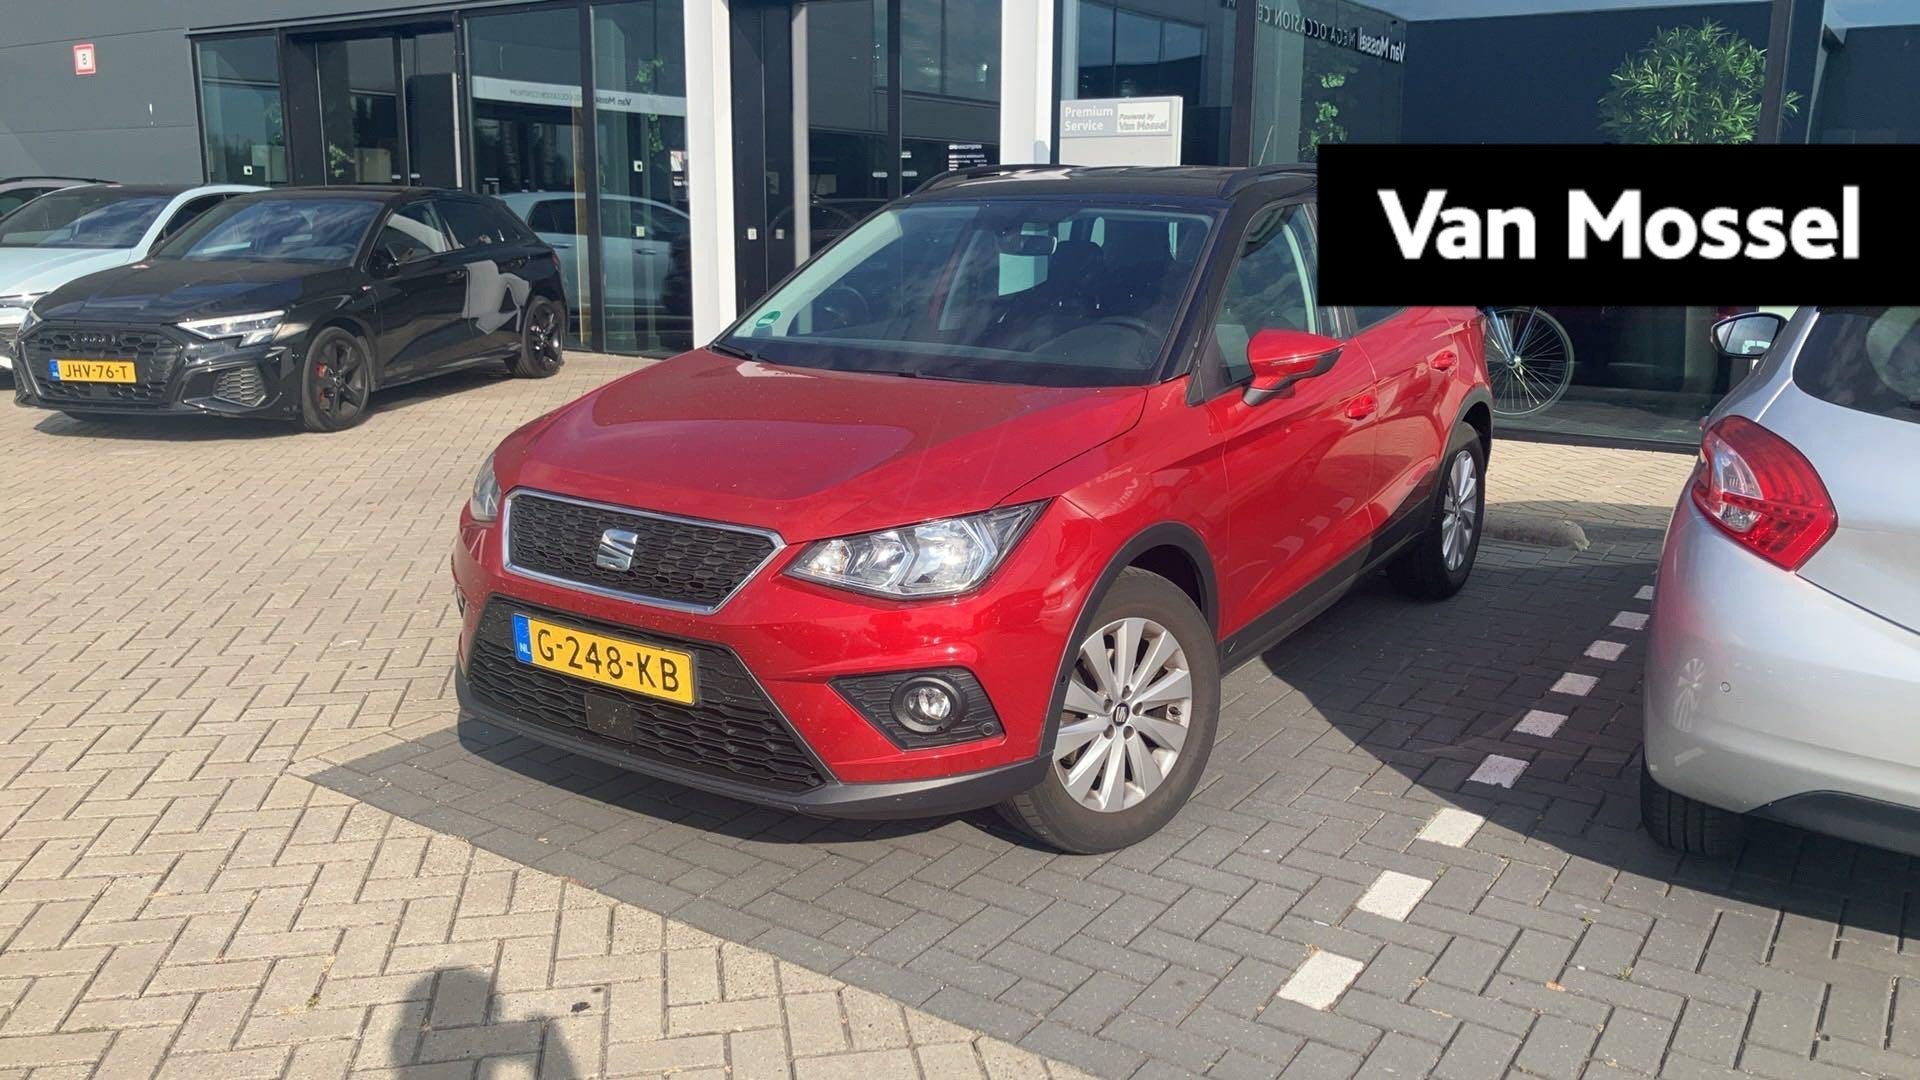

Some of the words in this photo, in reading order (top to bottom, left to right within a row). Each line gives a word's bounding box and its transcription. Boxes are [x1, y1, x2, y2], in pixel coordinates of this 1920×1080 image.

[1065, 105, 1113, 118] Premium
[1064, 120, 1104, 132] Service
[1119, 121, 1136, 131] Van
[65, 364, 128, 379] JHV-76-T
[519, 641, 531, 655] NL
[537, 628, 680, 693] G-248-KB
